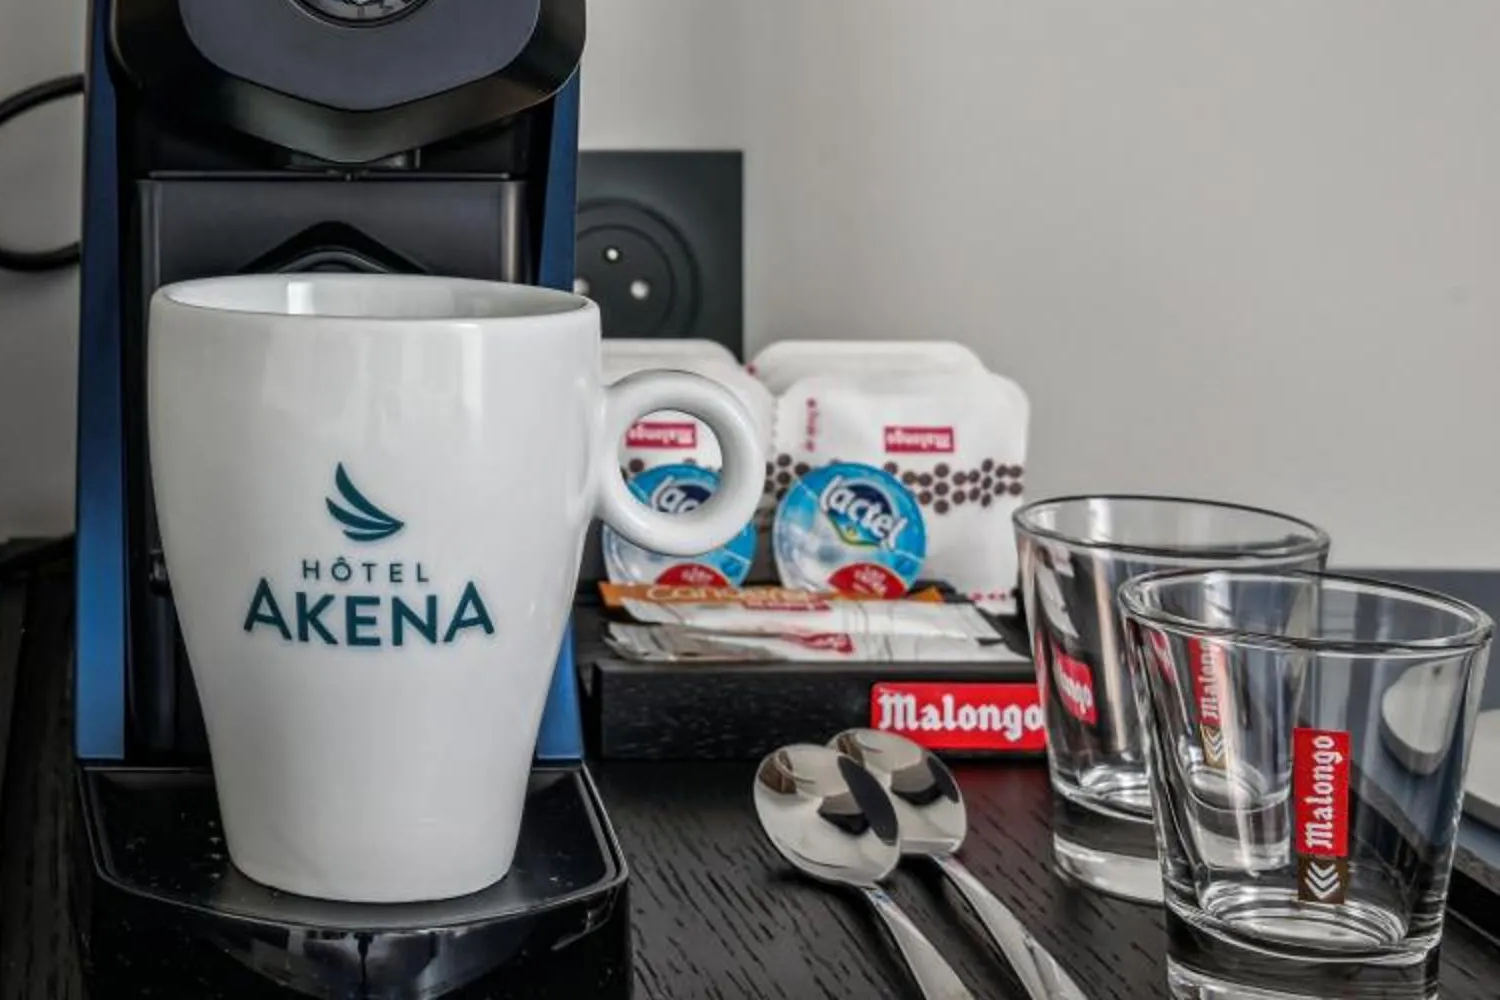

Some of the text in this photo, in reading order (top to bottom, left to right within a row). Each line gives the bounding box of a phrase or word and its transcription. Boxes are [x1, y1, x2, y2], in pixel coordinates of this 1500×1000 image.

[302, 556, 430, 583] HÔTEL
[242, 576, 496, 648] AKENA
[878, 690, 1046, 742] Malongo
[1303, 735, 1343, 849] Malongo
